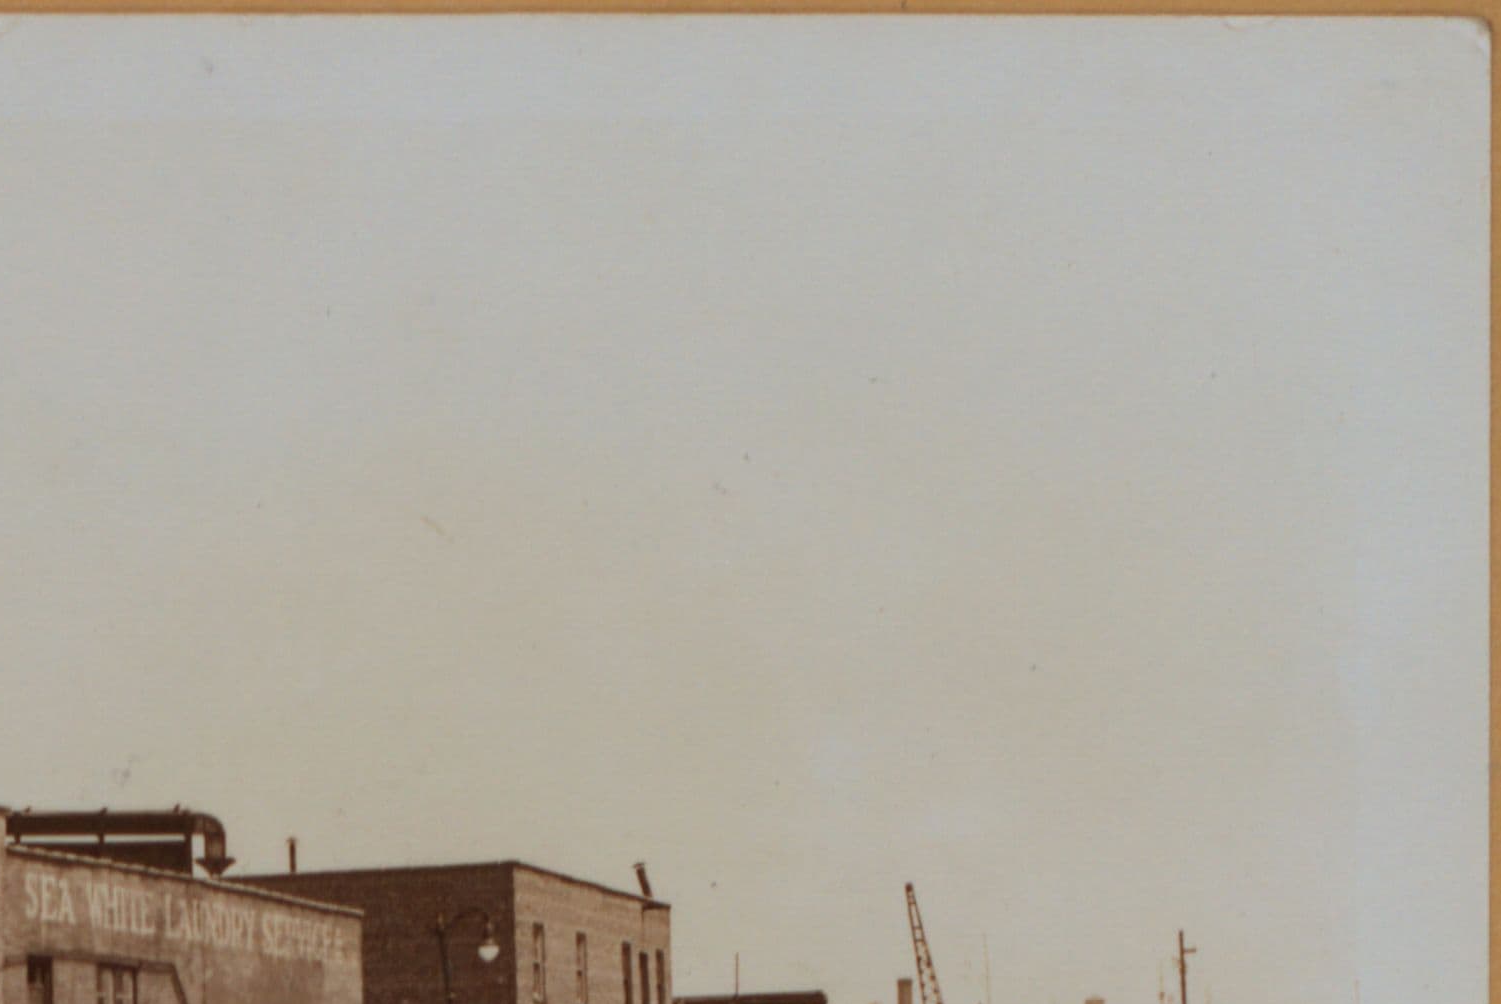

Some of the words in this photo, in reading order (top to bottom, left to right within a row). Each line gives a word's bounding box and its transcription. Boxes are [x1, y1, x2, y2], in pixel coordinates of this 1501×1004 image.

[23, 871, 77, 926] SEA
[85, 880, 156, 936] WHITE
[164, 893, 256, 950] LAUNDRY
